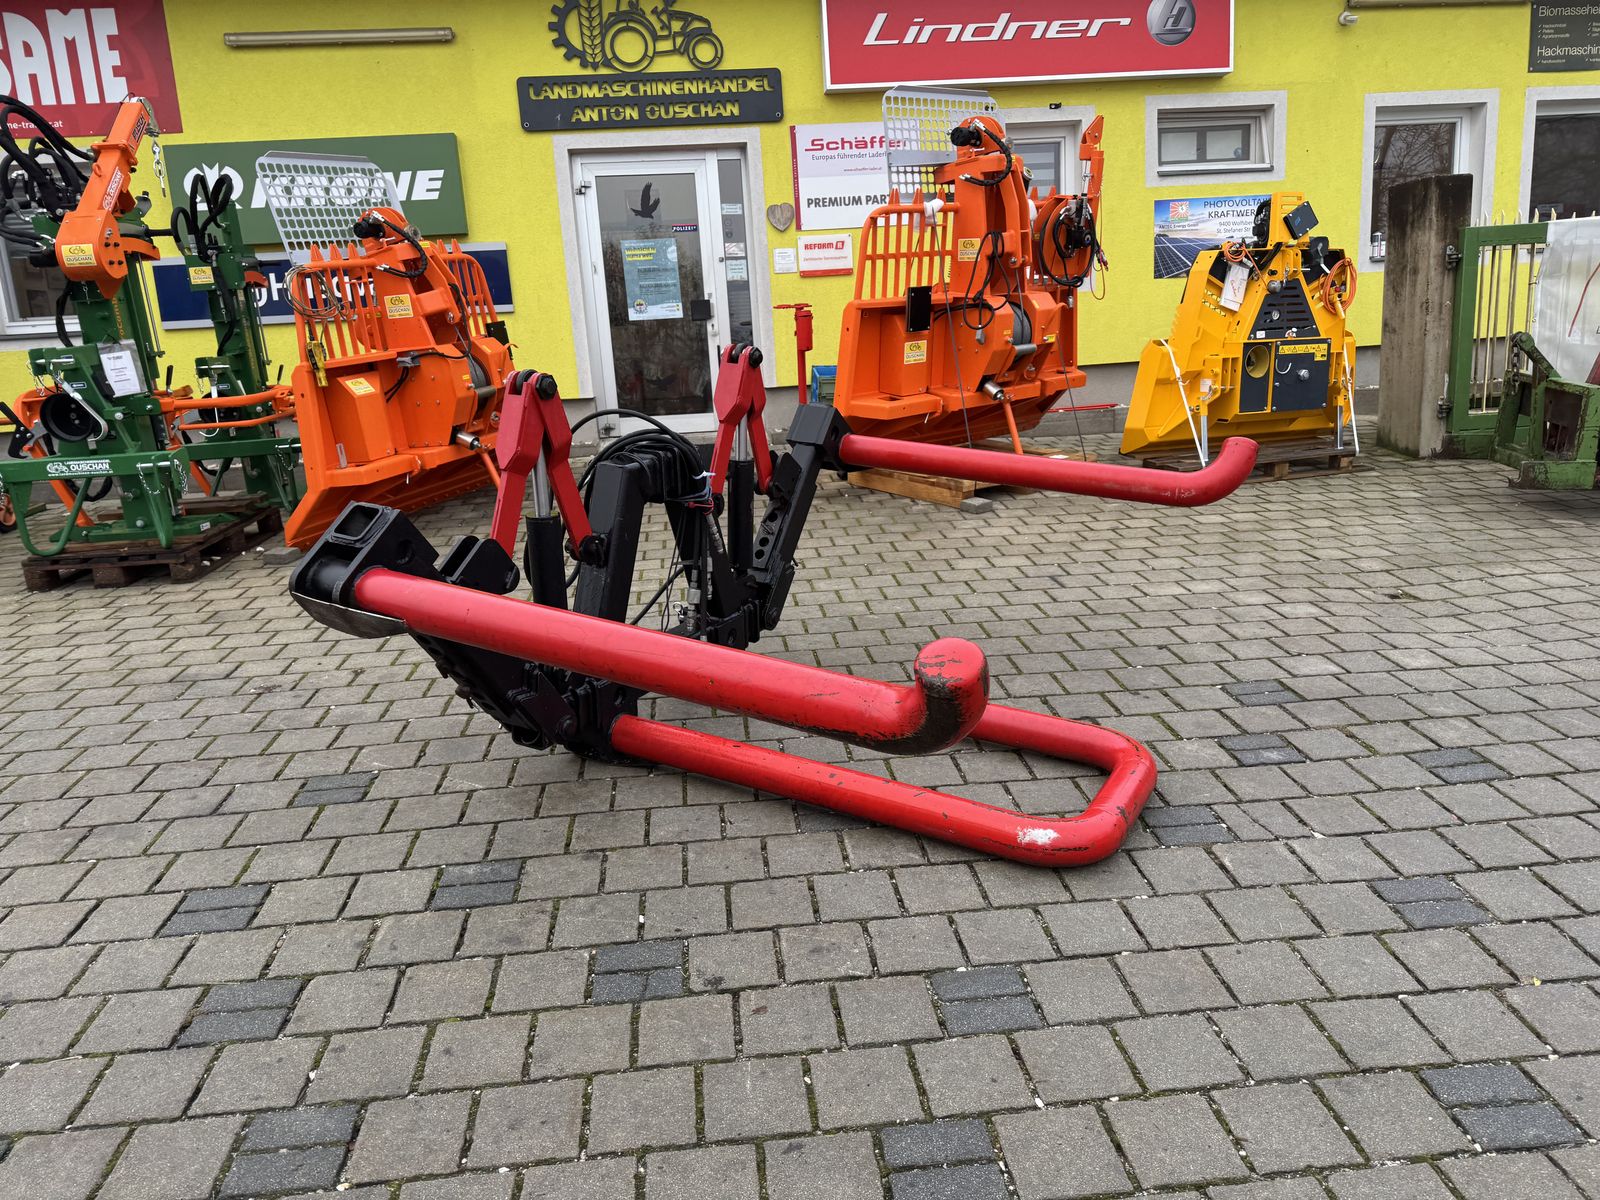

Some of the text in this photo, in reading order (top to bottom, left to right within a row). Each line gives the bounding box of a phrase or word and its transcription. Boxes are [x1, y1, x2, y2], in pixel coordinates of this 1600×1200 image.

[863, 12, 1132, 46] Lindner
[528, 75, 775, 100] LANDMASCHINENHANDEL
[571, 100, 740, 123] ANTON OUSCHAN
[811, 154, 837, 162] Europas
[837, 151, 868, 160] führender
[807, 195, 863, 208] PREMIUM
[1203, 198, 1267, 209] PHOTOVOLTA
[1208, 208, 1256, 219] KRAFTWER
[804, 242, 834, 251] REFORM
[70, 462, 110, 471] OUSCHAN
